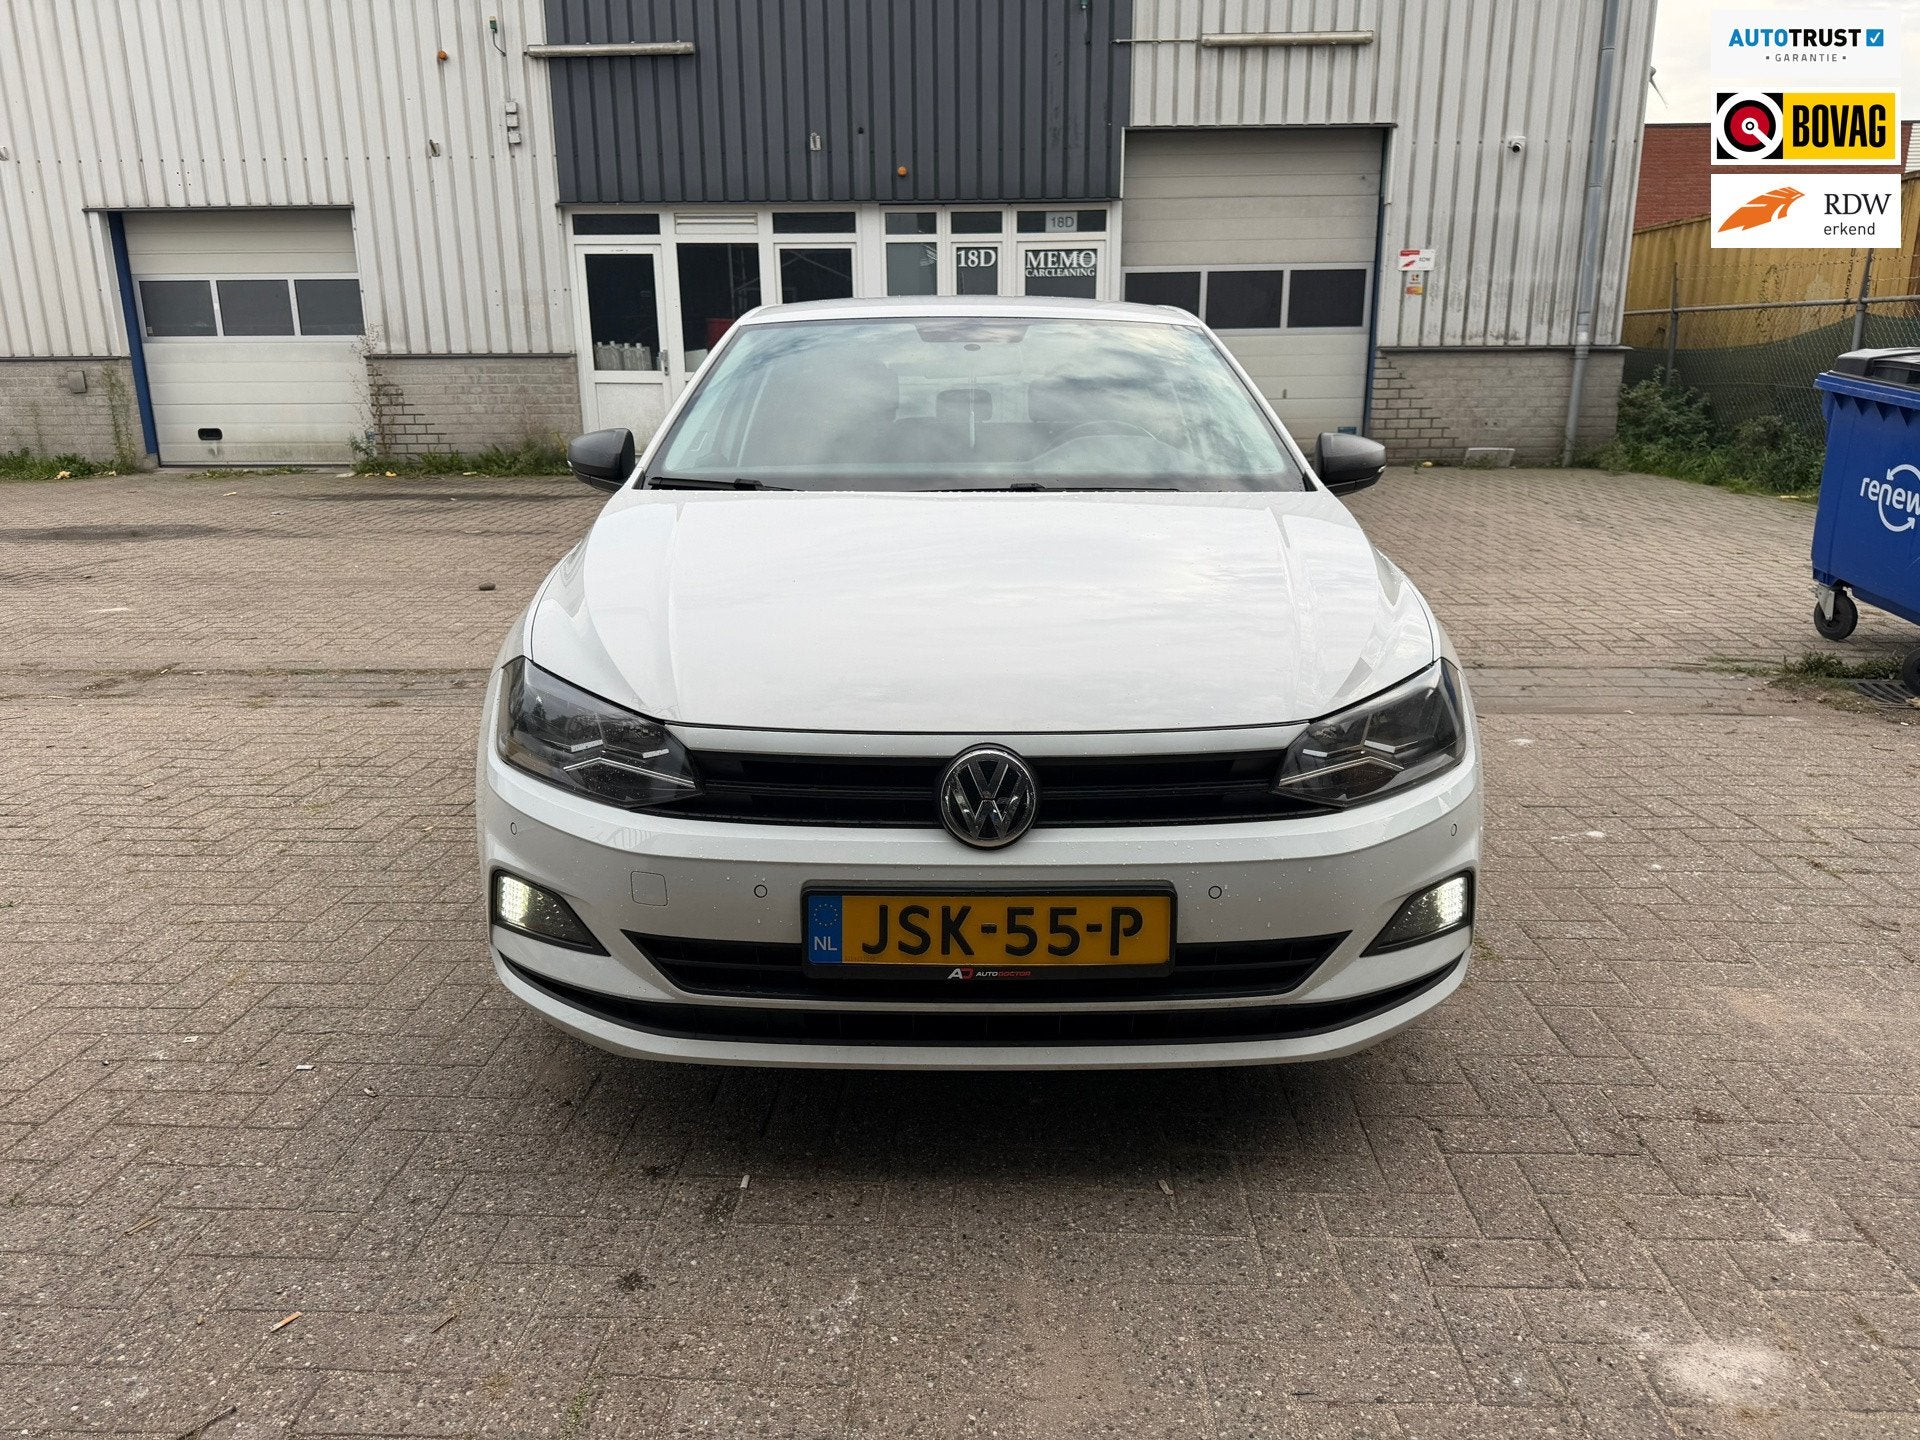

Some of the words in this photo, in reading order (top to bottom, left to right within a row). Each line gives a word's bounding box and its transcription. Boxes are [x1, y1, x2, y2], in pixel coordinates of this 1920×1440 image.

[1050, 216, 1075, 228] 18D
[957, 249, 997, 268] 18D
[1025, 250, 1097, 268] MEMO
[1025, 267, 1096, 278] CARCLEANING
[861, 904, 1144, 957] JSK-55-P
[813, 936, 838, 951] NL
